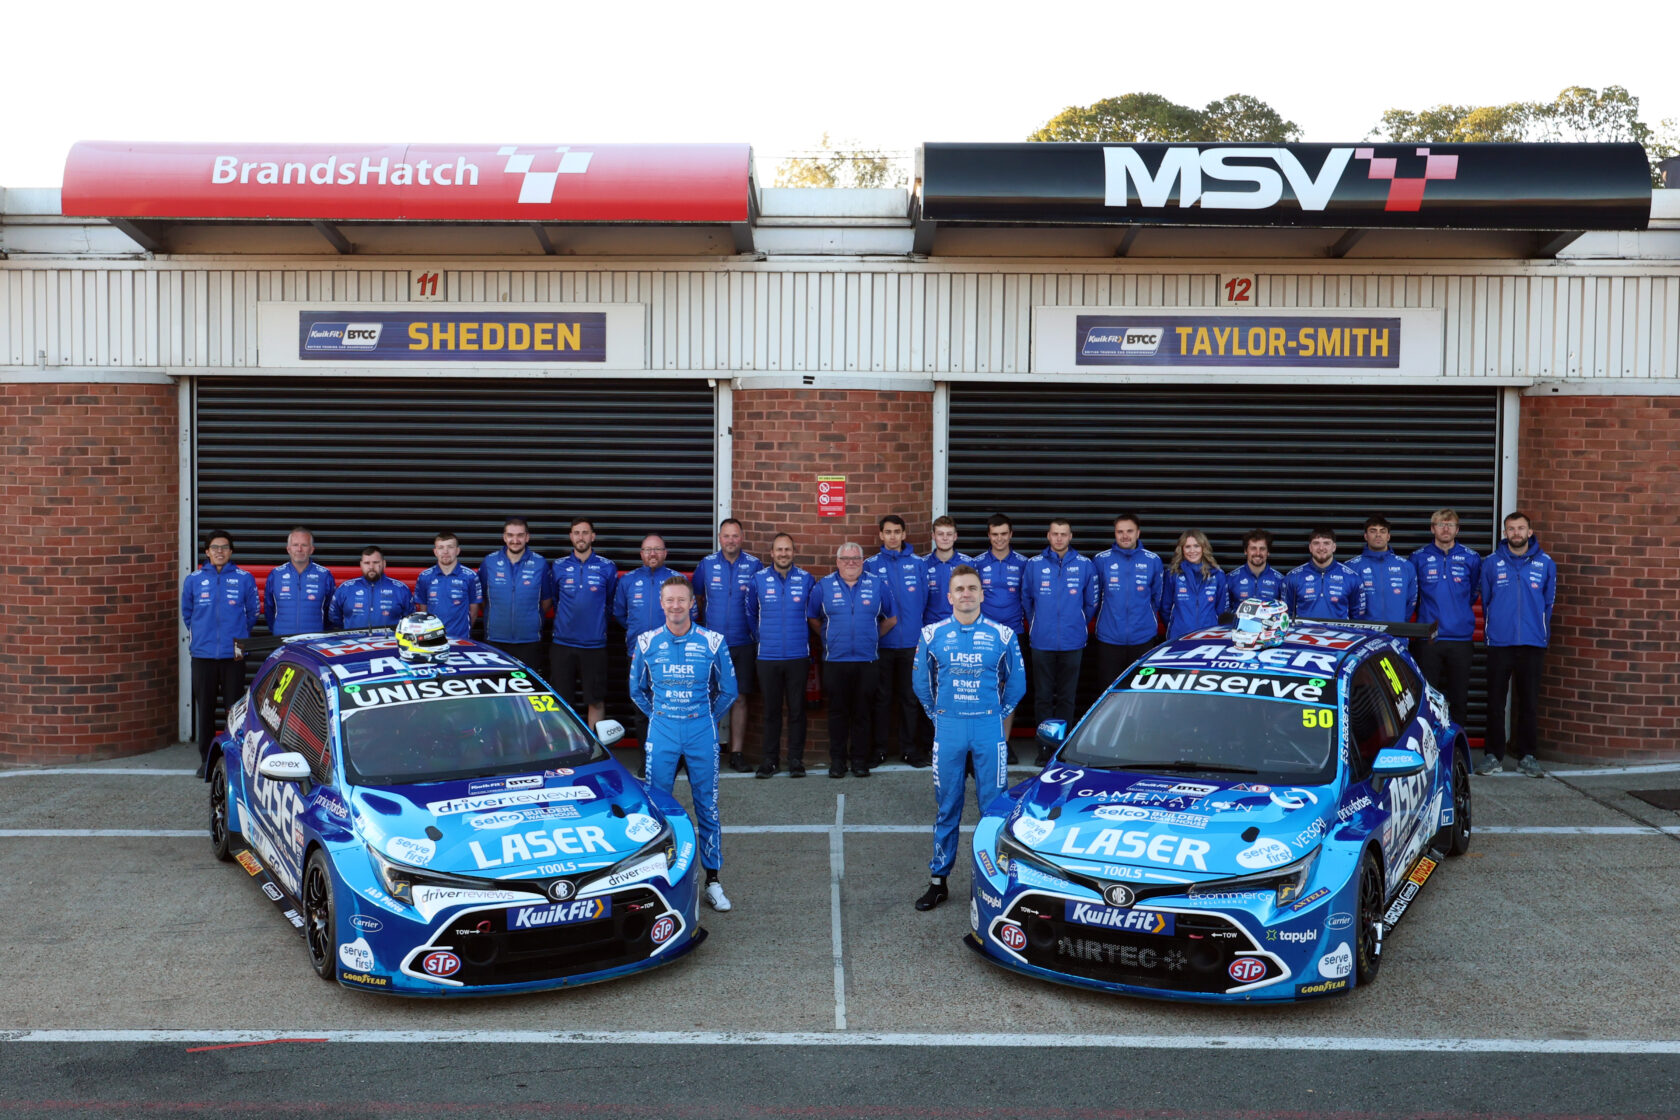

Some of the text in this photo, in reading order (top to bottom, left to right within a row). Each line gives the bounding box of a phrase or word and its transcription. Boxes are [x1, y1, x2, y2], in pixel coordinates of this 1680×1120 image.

[211, 155, 479, 186] BrandsHatch
[1103, 147, 1355, 211] MSV
[417, 273, 439, 296] 11
[1224, 277, 1252, 302] 12
[348, 330, 376, 340] BTCC
[408, 322, 581, 351] SHEDDEN
[1127, 334, 1157, 345] BTCC
[1175, 326, 1389, 358] TAYLOR-SMITH
[950, 652, 983, 663] LASER
[1210, 660, 1260, 670] TOOLS
[663, 664, 695, 674] LASER
[528, 695, 560, 713] 52
[1302, 709, 1334, 729] 50
[474, 811, 523, 828] selco
[1098, 807, 1146, 818] selco
[1149, 811, 1209, 822] BUILDERS
[396, 838, 430, 854] serve
[469, 826, 616, 869] LASER
[1060, 828, 1211, 871] LASER
[1243, 843, 1280, 859] serve
[536, 861, 576, 876] TOOLS
[1103, 866, 1143, 879] TOOLS
[1292, 889, 1328, 911] AXTELL
[353, 918, 379, 929] Carrier
[1327, 916, 1351, 927] Carrier
[655, 921, 672, 942] STP
[1003, 927, 1024, 948] STP
[1280, 929, 1317, 944] tapybl
[344, 945, 369, 958] serve
[1058, 938, 1158, 968] AIRTEC
[1324, 953, 1349, 965] serve
[427, 952, 456, 973] STP
[1233, 960, 1261, 979] STP
